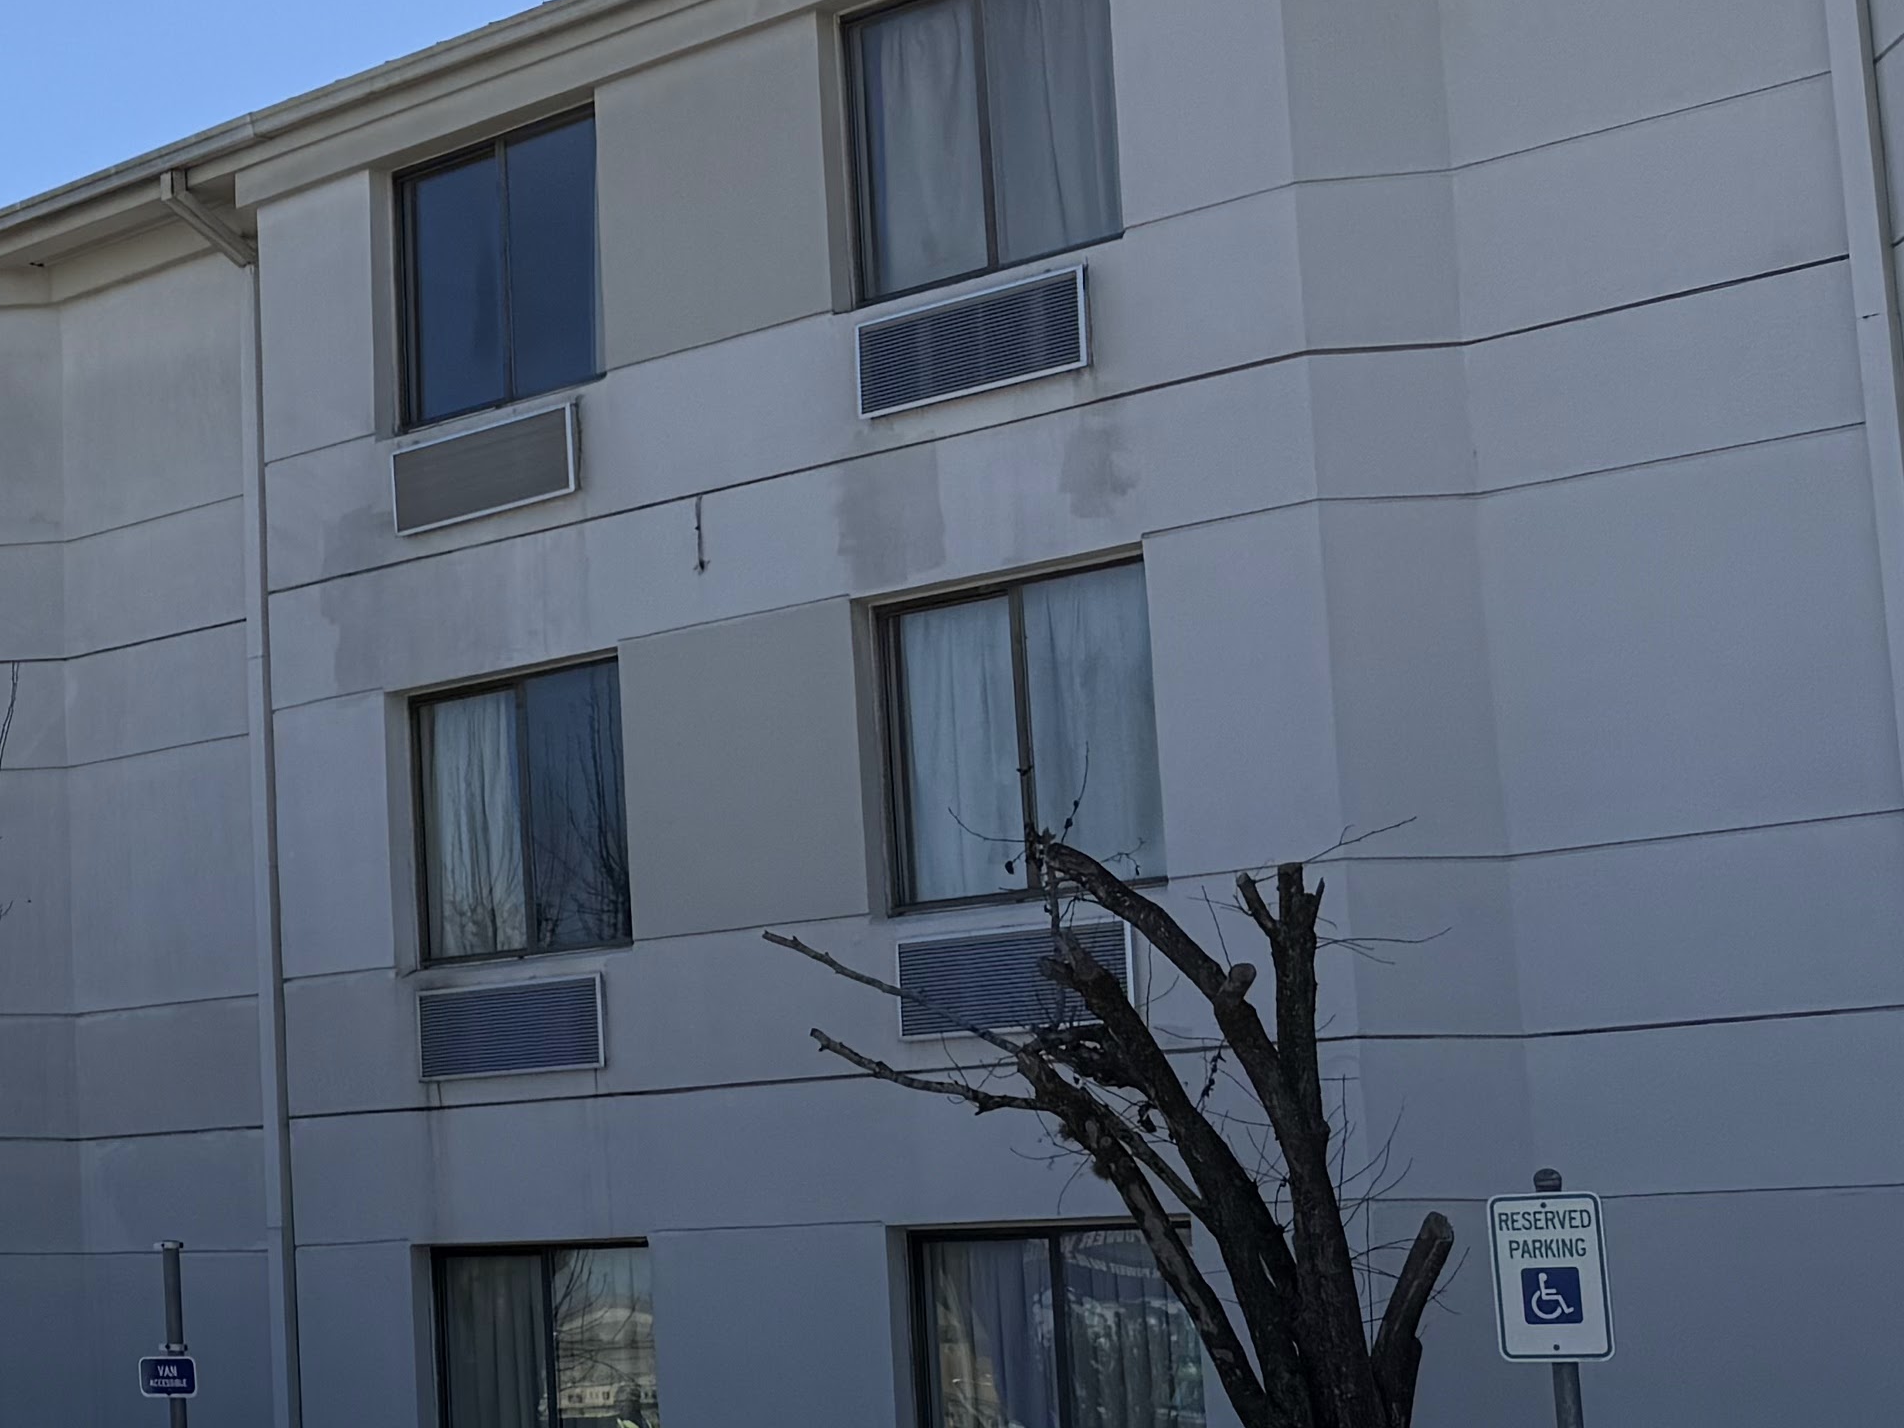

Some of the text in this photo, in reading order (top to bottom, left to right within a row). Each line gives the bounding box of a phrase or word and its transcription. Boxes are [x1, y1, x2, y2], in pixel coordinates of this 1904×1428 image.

[1498, 1209, 1591, 1231] RESERVED
[1509, 1238, 1586, 1259] PARKING
[157, 1365, 178, 1377] VAN
